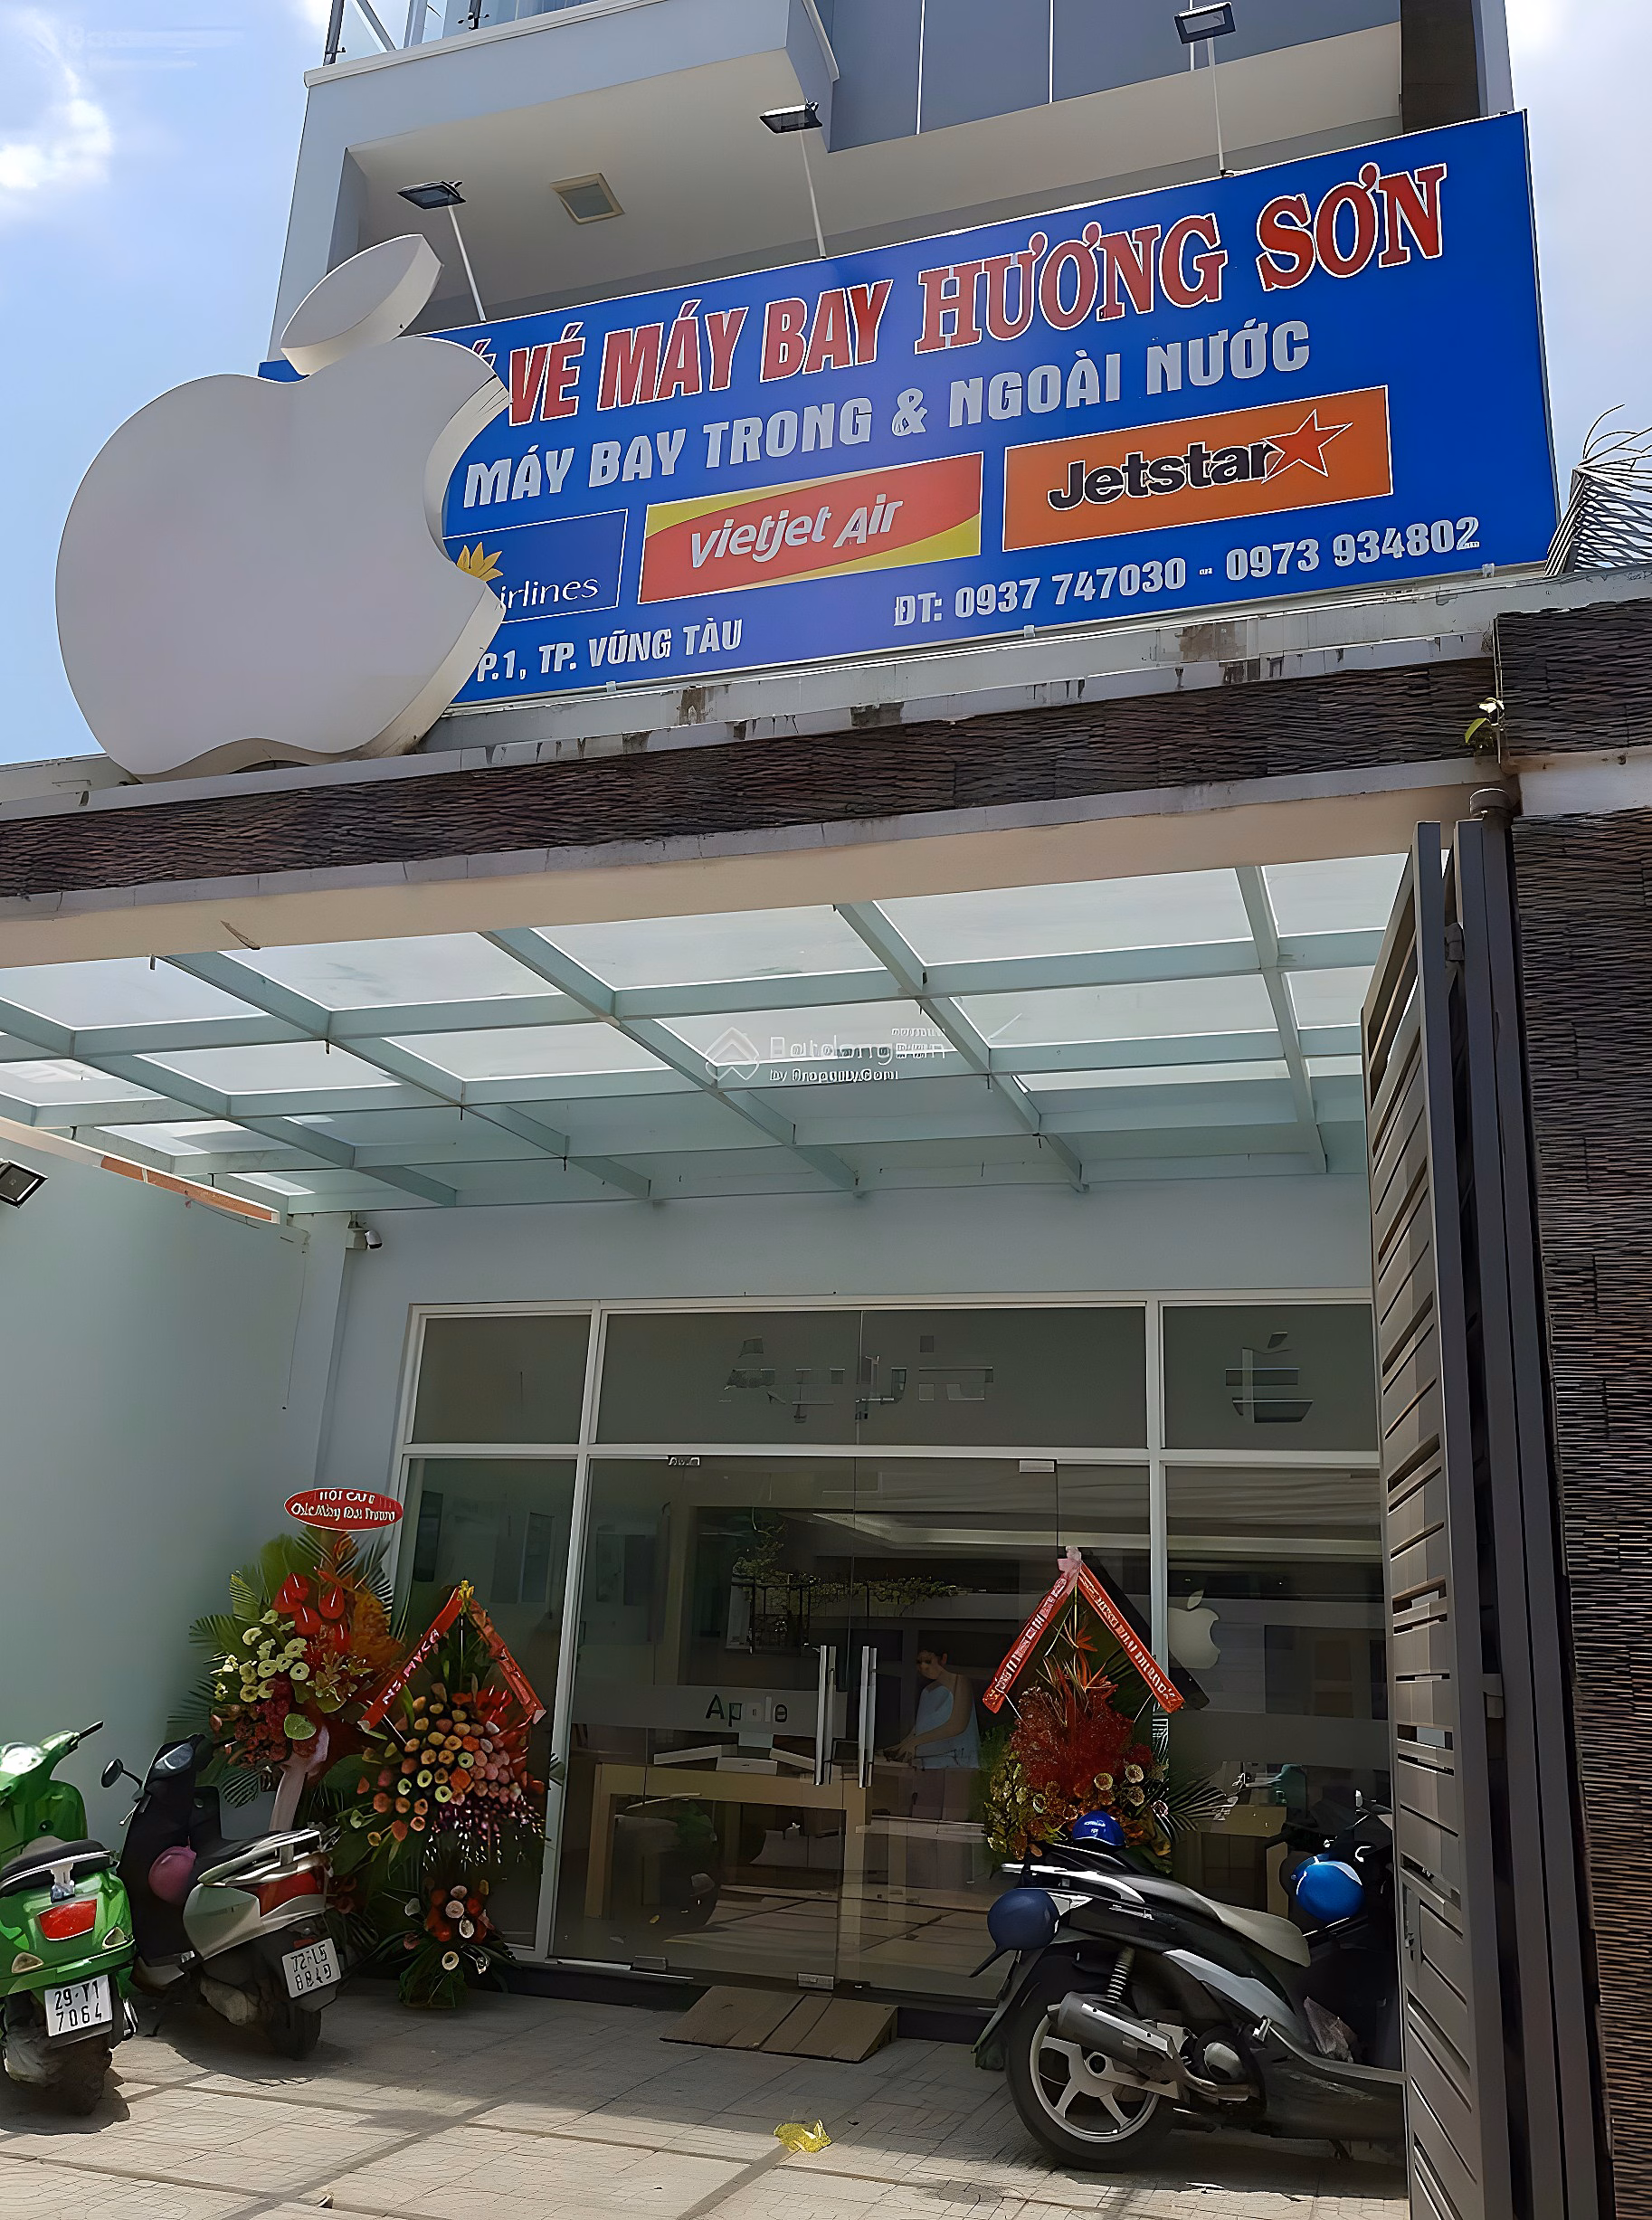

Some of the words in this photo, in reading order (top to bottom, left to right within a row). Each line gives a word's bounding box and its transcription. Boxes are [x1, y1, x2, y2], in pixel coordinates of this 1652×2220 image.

[508, 322, 585, 427] VÉ
[596, 299, 749, 413] MÁY
[758, 279, 896, 384] BAY
[914, 212, 1228, 355] HƯƠNG
[1256, 161, 1448, 293] SƠN
[463, 445, 575, 508] MÁY
[588, 429, 688, 489] BAY
[702, 396, 874, 470] TRONG
[890, 386, 928, 438] &
[948, 348, 1123, 429] NGOÀI
[1145, 318, 1312, 394] NƯỚC
[1046, 439, 1273, 512] Jetstar
[690, 507, 832, 570] Vietjet
[833, 493, 905, 548] Air
[499, 574, 600, 610] irlines
[893, 593, 944, 627] ĐT:
[954, 575, 1040, 617] 0937
[1051, 555, 1187, 606] 747030
[1226, 536, 1321, 583] 0973
[1333, 516, 1481, 566] 934802
[538, 640, 578, 675] TP.
[588, 626, 673, 668] VŨNG
[683, 615, 745, 657] TÀU
[55, 2002, 102, 2032] 7064
